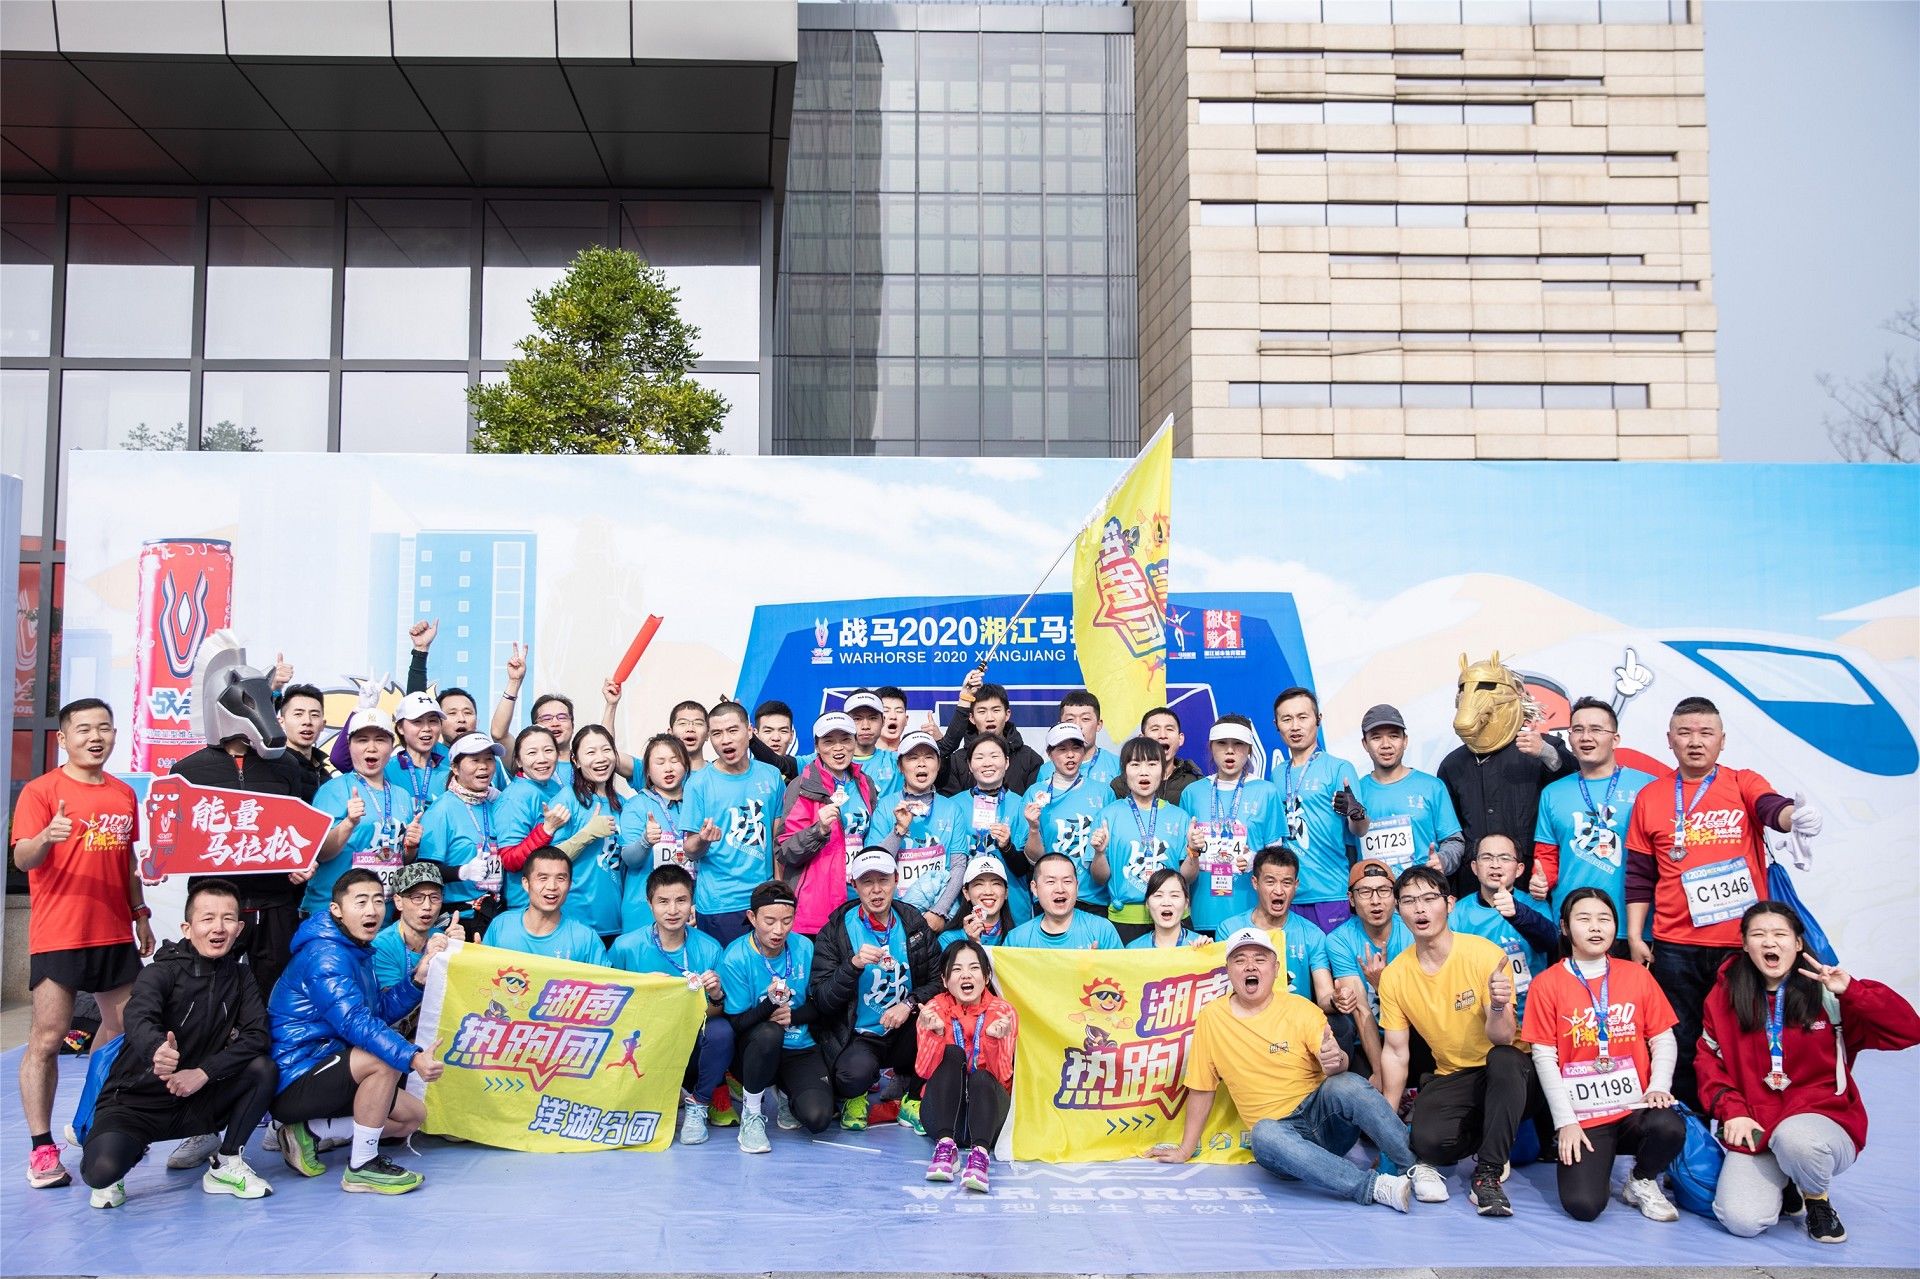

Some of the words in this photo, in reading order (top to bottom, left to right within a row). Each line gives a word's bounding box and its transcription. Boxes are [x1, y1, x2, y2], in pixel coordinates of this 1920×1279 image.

[839, 652, 927, 664] WARHORSE
[934, 651, 968, 663] 2020
[975, 649, 1066, 662] XIANGJIANG
[191, 795, 265, 834] 能量
[1691, 808, 1745, 832] 2020
[200, 825, 313, 868] 马拉松
[1365, 832, 1407, 851] C1723
[1697, 876, 1749, 902] C1346
[535, 982, 628, 1022] 湖南
[1584, 1002, 1636, 1029] 220
[449, 1014, 612, 1078] 热跑团
[1057, 1035, 1194, 1107] 热跑
[1576, 1077, 1633, 1101] D1198
[529, 1095, 661, 1146] 洋湖分团
[1054, 1187, 1268, 1201] HORSE
[903, 1203, 1278, 1215] 能量型维生素饮料
